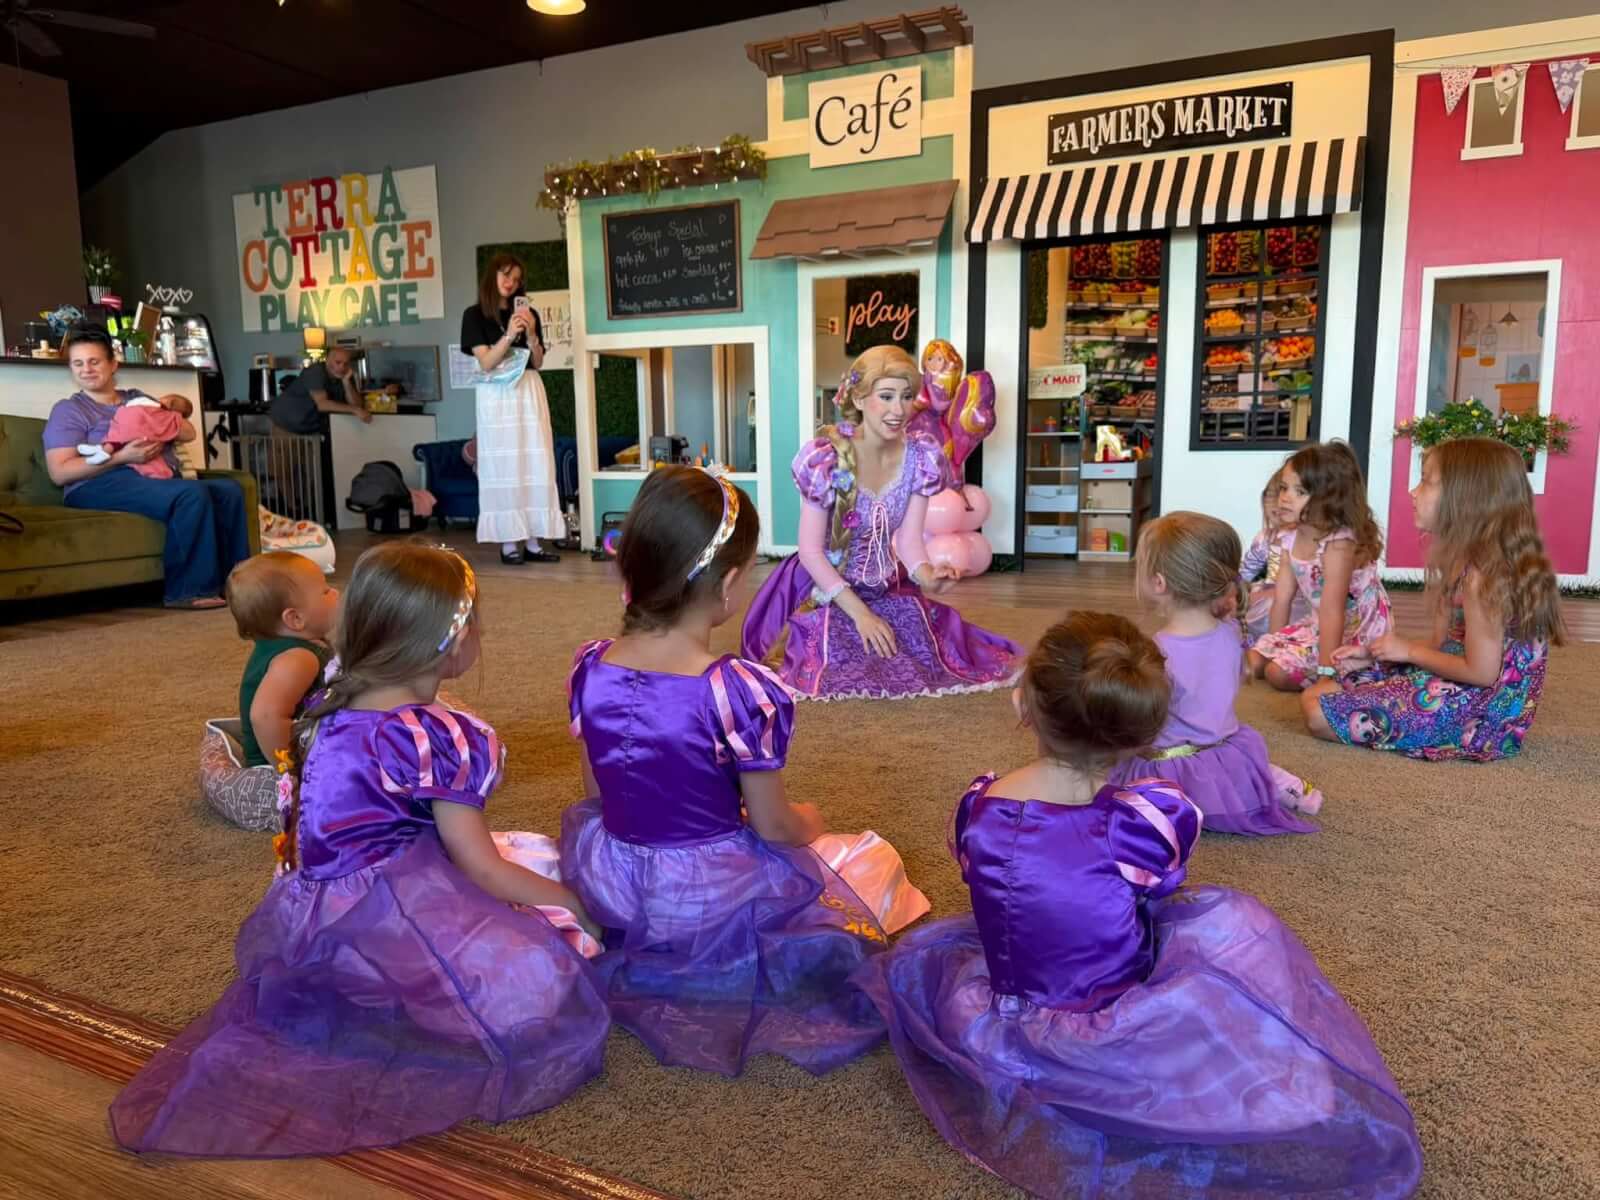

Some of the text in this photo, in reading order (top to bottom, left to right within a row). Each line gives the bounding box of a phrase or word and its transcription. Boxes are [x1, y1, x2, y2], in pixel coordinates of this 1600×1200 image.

[815, 73, 912, 154] Café
[1052, 96, 1287, 154] FARMERS MARKET
[254, 165, 406, 239] TERRA
[243, 221, 435, 293] COTTAGE
[259, 282, 420, 334] PLAY CAFE
[846, 290, 918, 344] play
[1053, 374, 1082, 385] MART
